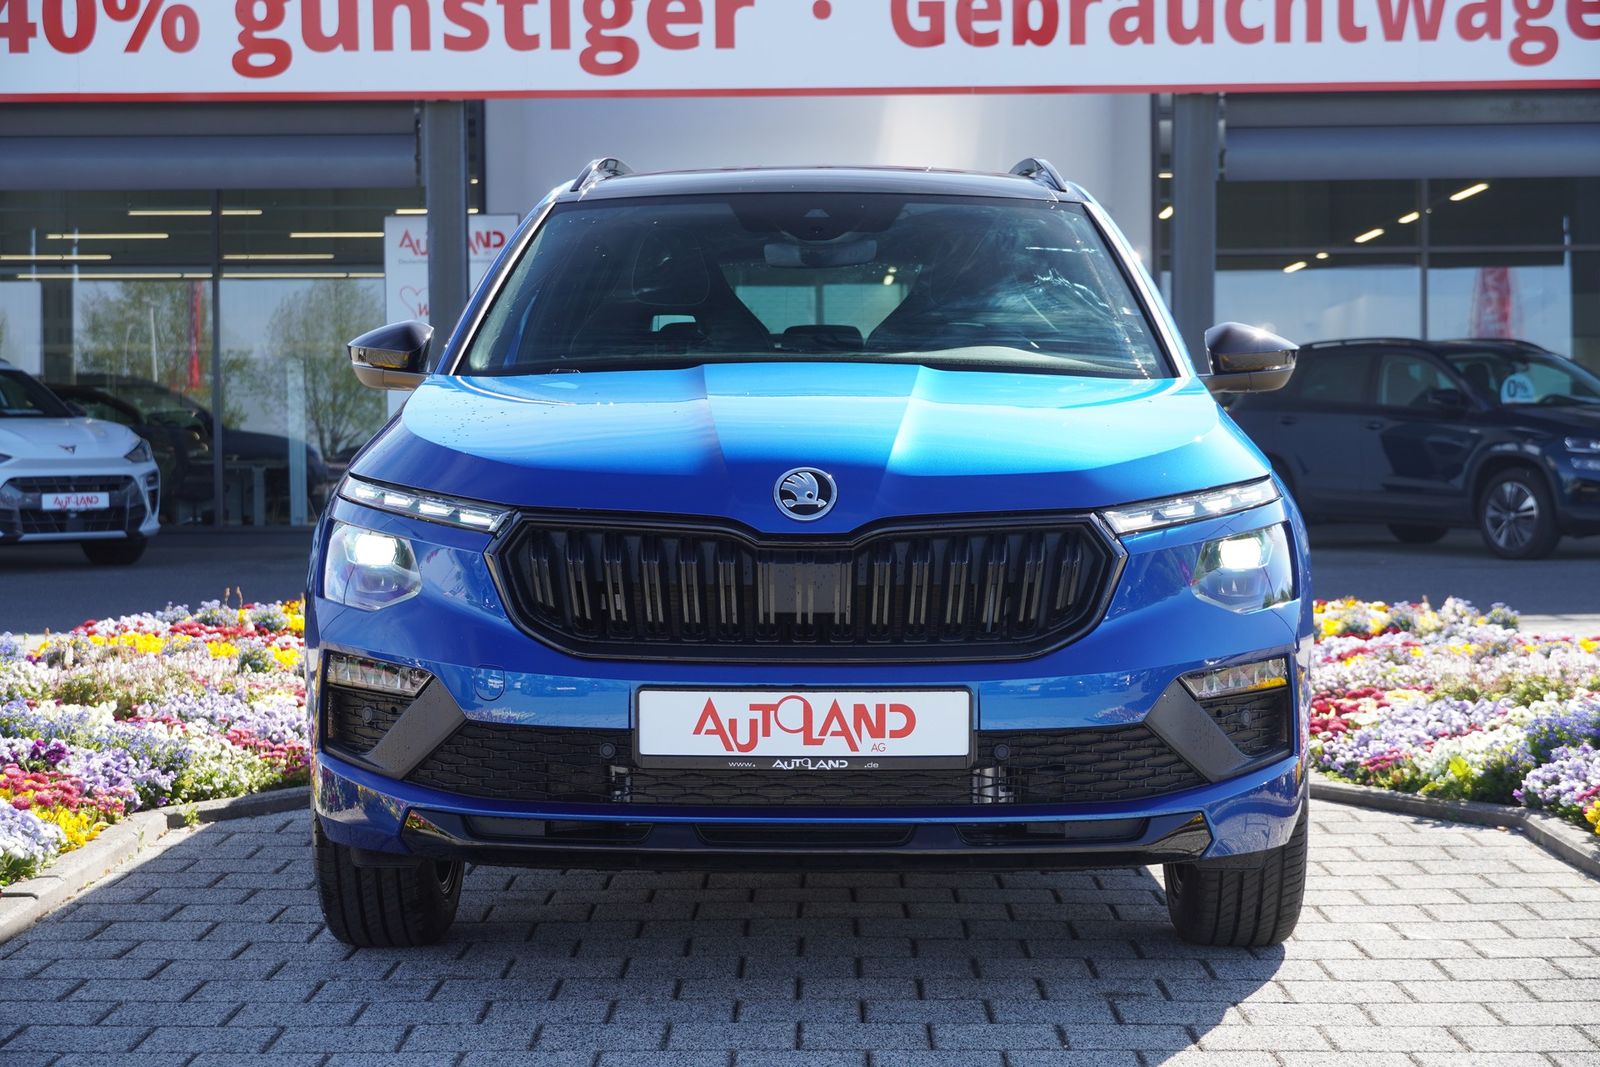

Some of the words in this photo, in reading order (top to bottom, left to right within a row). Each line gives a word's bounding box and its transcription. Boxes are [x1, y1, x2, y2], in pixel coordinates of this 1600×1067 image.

[692, 694, 916, 753] AUTOLAND
[871, 743, 886, 752] AG
[772, 757, 848, 770] AUTOLAND
